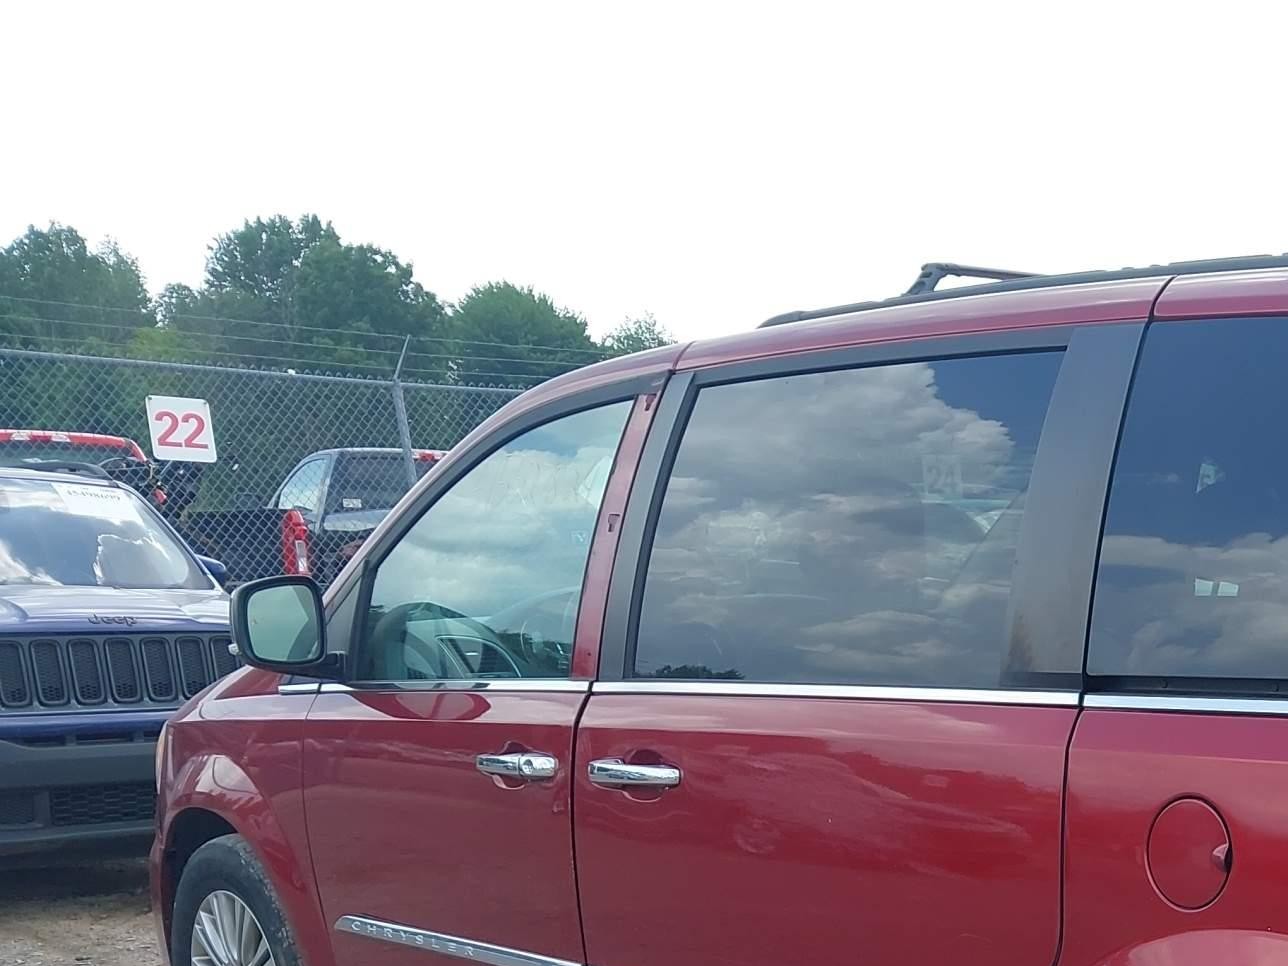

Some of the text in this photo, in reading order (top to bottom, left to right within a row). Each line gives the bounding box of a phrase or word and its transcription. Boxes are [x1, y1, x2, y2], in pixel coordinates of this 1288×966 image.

[155, 411, 209, 449] 22
[88, 613, 137, 627] Jeep
[351, 922, 475, 957] CHRYSLER
